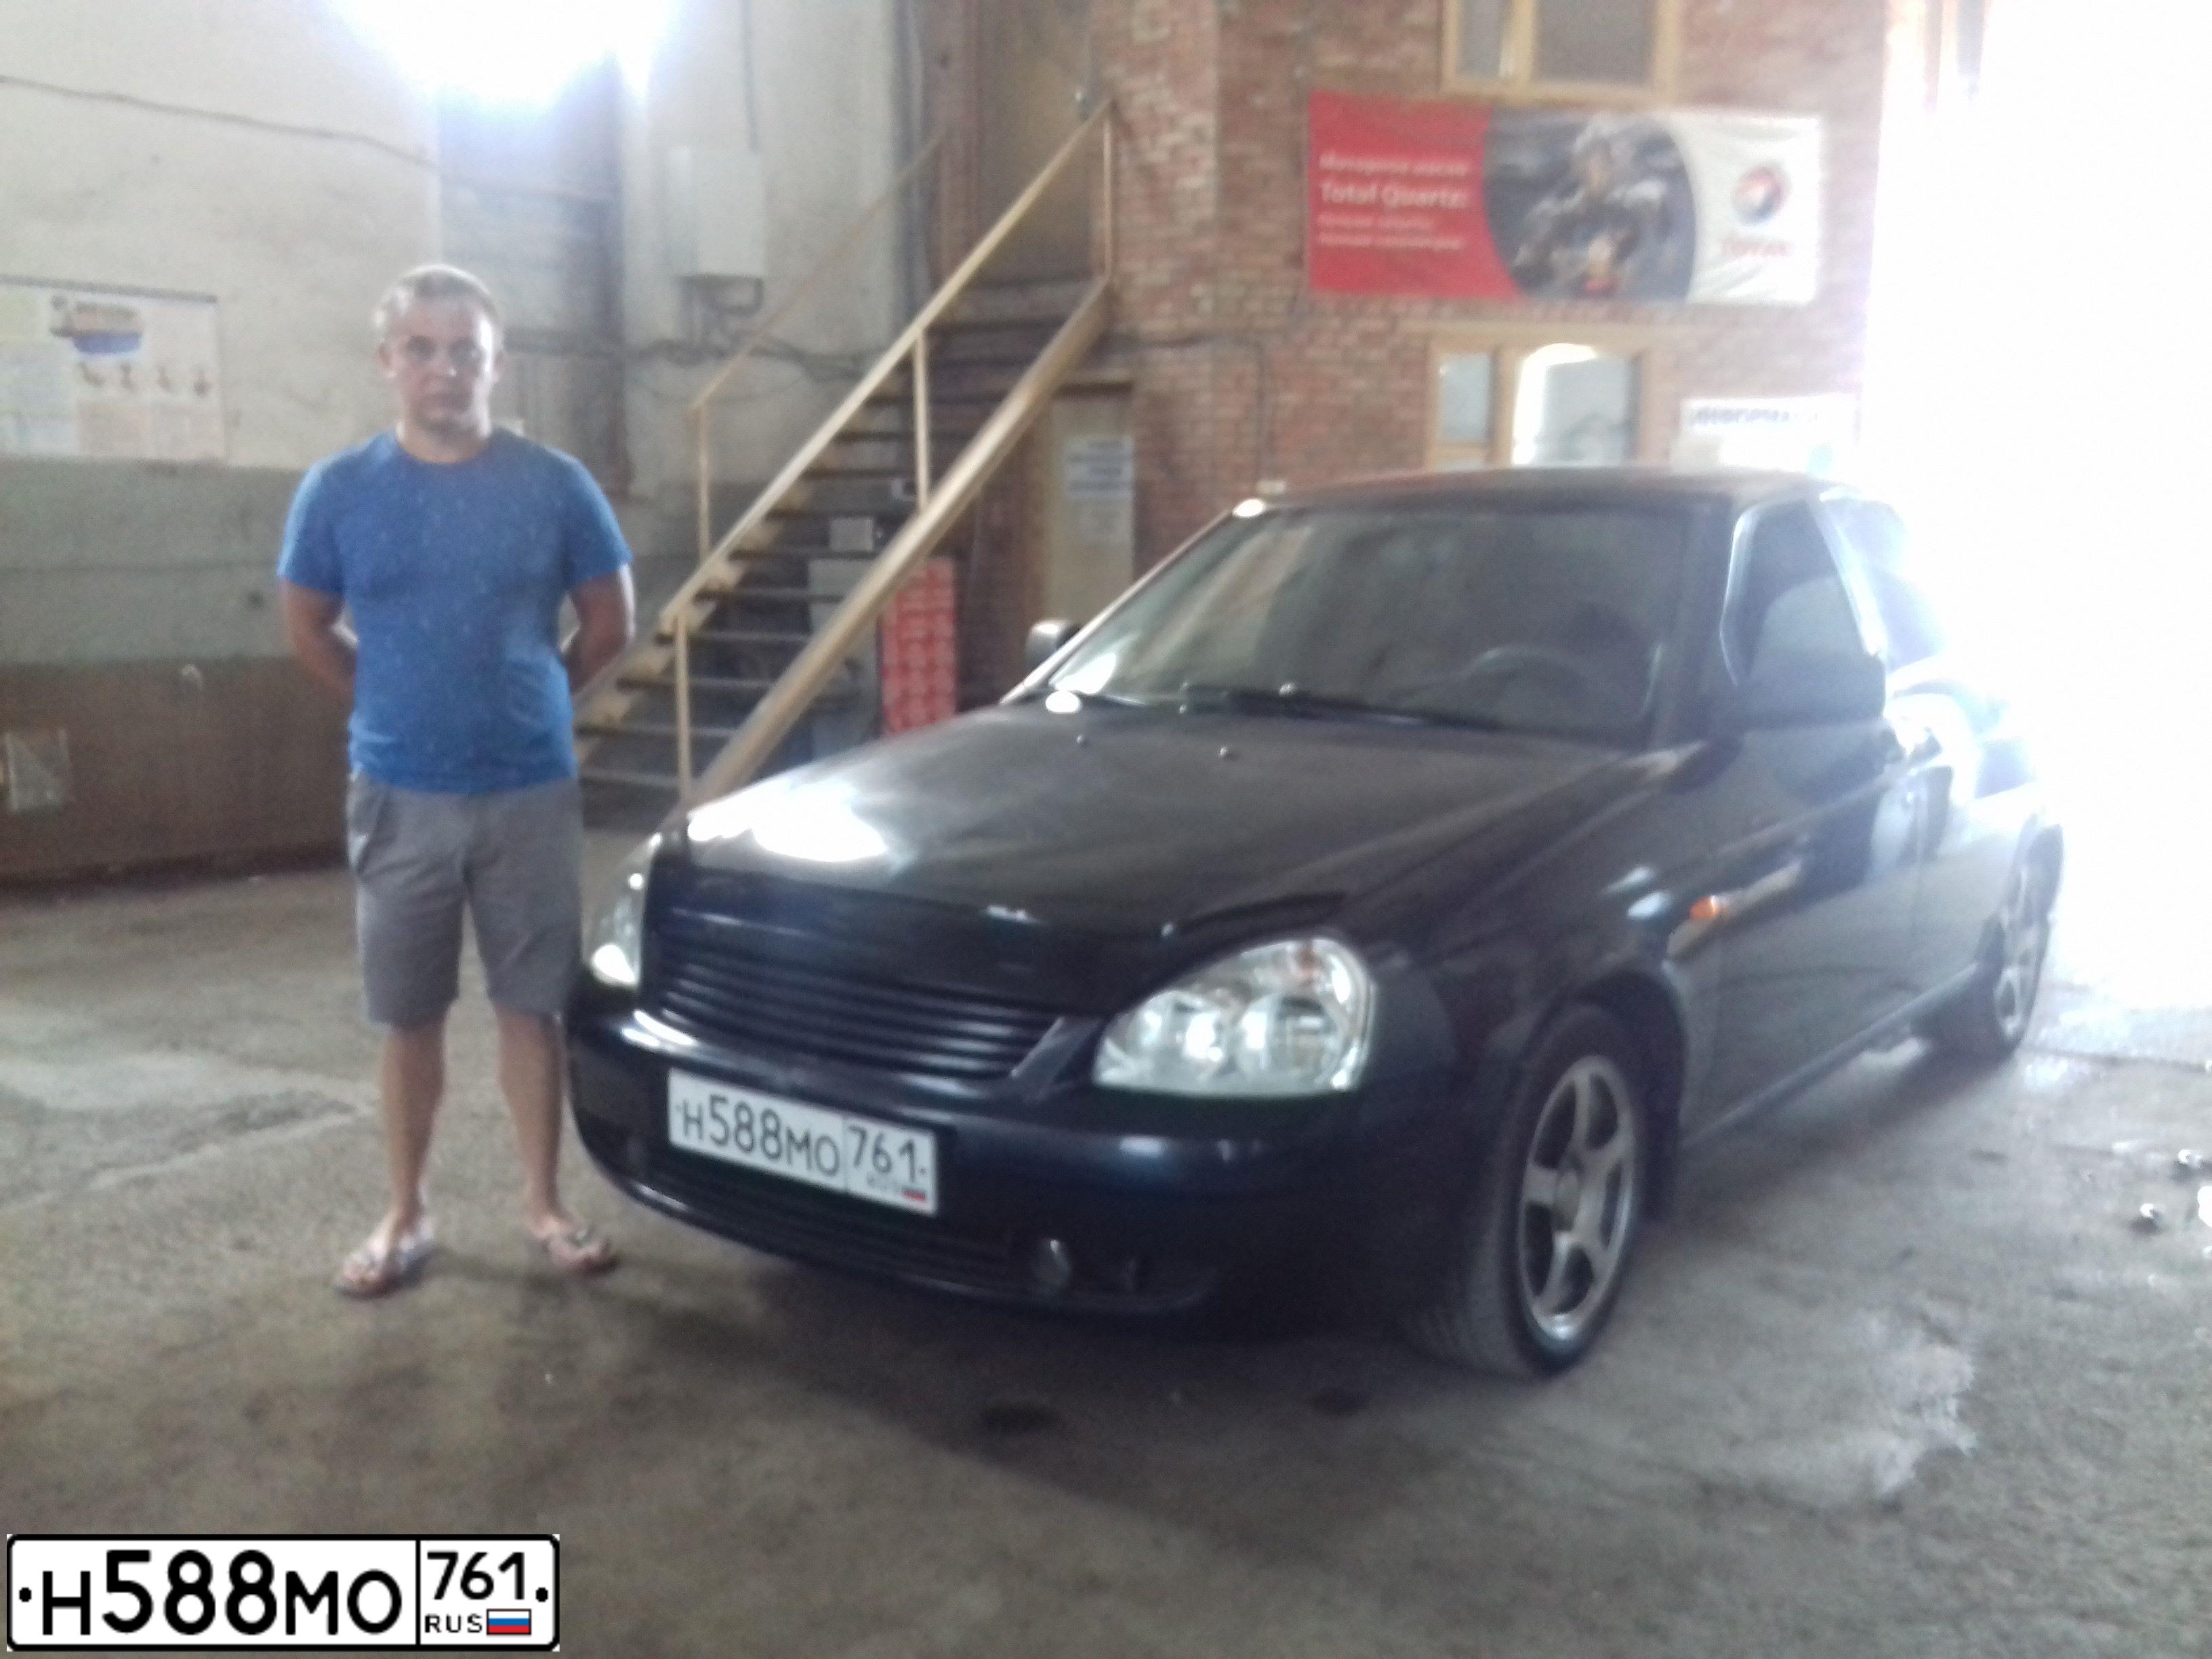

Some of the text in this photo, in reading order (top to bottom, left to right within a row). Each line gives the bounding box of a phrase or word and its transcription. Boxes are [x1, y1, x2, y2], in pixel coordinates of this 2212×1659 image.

[1319, 181, 1376, 204] Total
[682, 1094, 916, 1183] Н588МО 761
